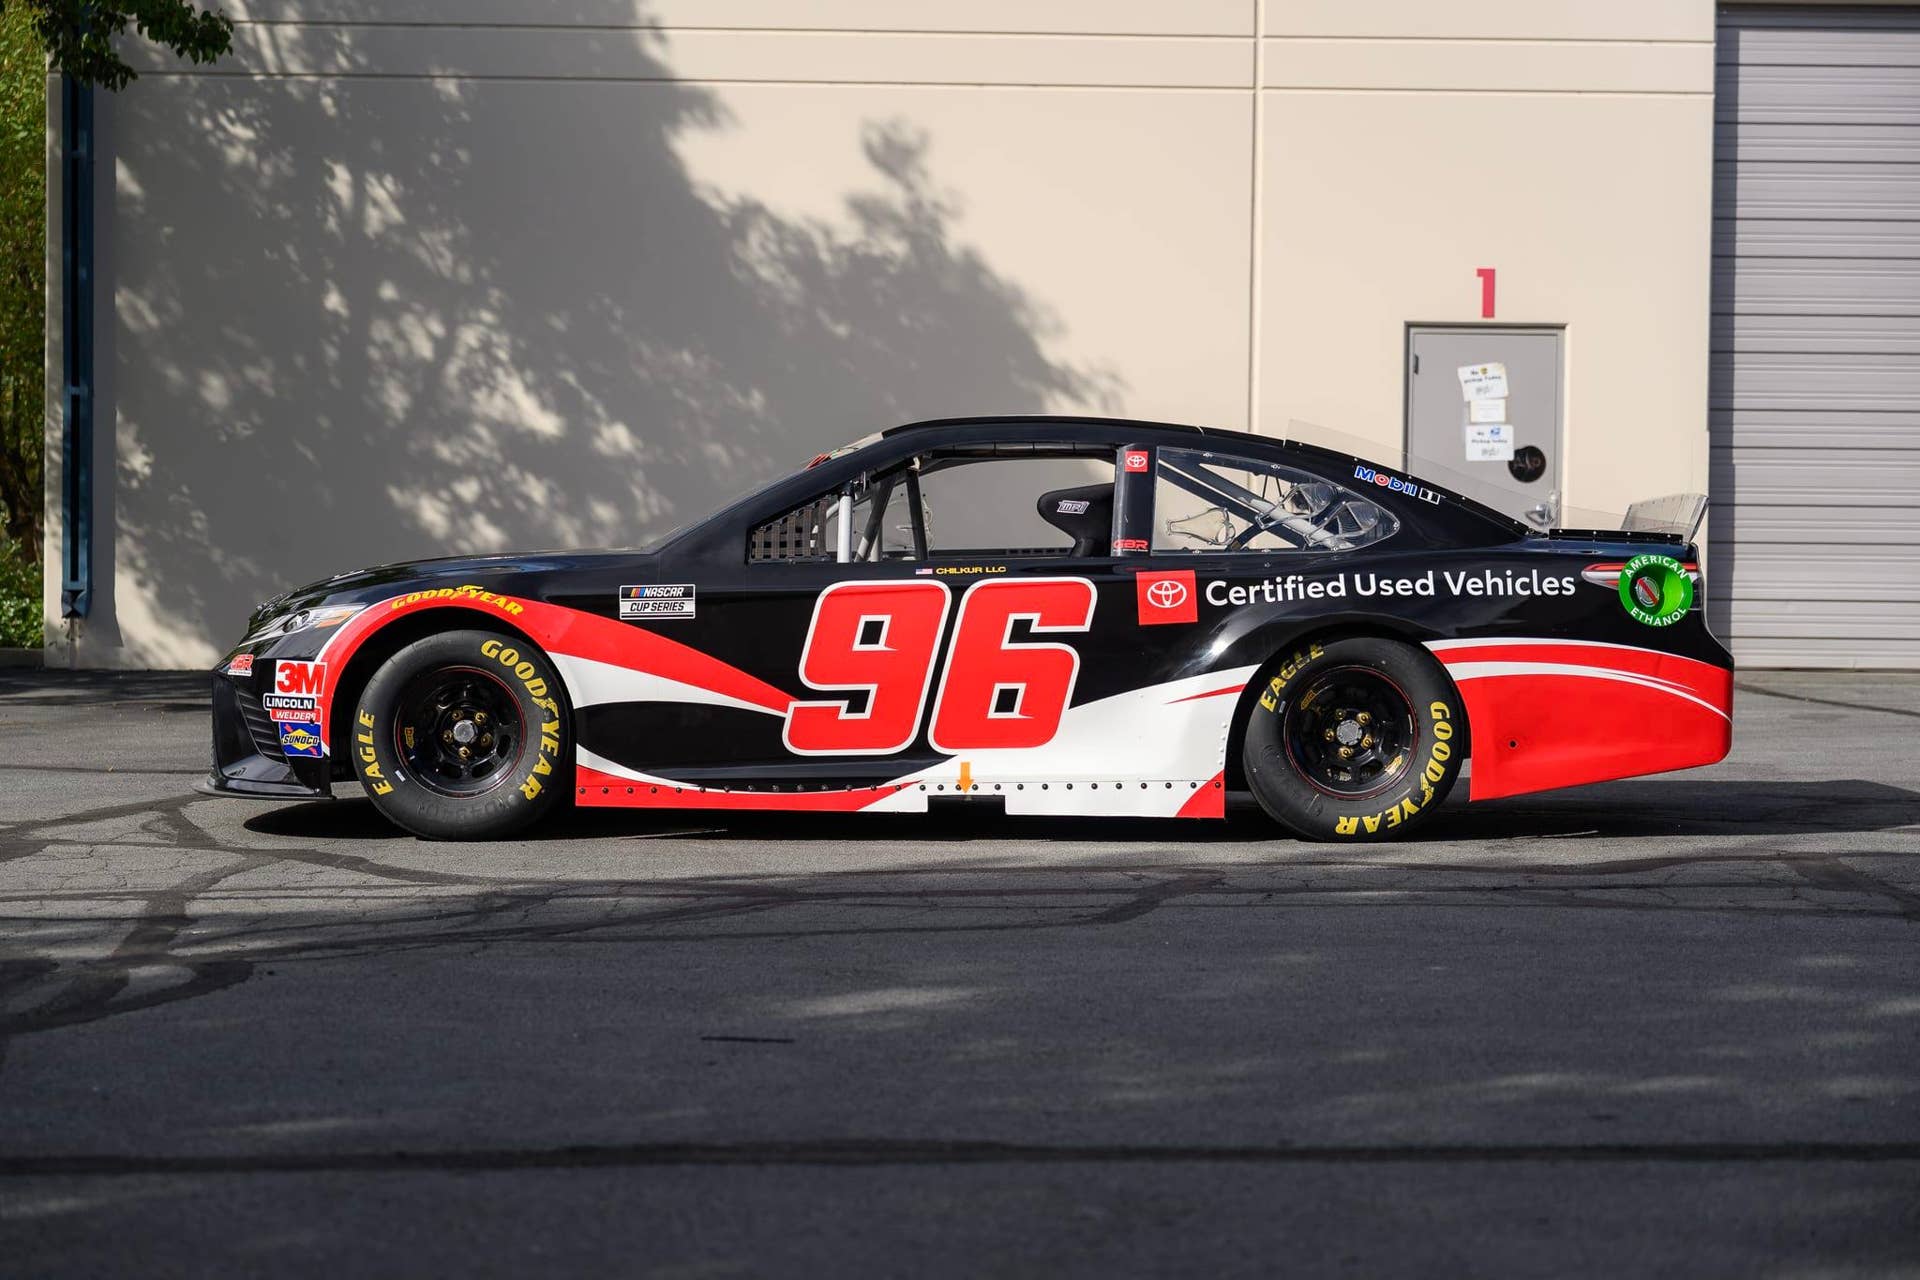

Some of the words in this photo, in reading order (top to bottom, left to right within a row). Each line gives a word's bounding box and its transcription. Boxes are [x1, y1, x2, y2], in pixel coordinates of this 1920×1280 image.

[1476, 268, 1496, 319] 1
[1354, 465, 1418, 497] Mobil
[1113, 538, 1149, 549] GBR
[935, 566, 983, 575] CHILKUR
[1625, 555, 1688, 580] AMERICAN
[391, 584, 524, 616] GOODYEAR
[643, 586, 685, 598] NASCAR
[1205, 573, 1346, 606] Certified
[1353, 570, 1435, 597] Used
[1443, 569, 1576, 597] Vehicles
[629, 602, 650, 612] CUP
[650, 601, 686, 612] SERIES
[1630, 607, 1687, 627] ETHANOL
[276, 662, 327, 695] 3M
[781, 577, 1099, 757] 96
[266, 697, 313, 710] LINCOLN
[276, 710, 316, 721] WELDERS
[480, 638, 560, 801] GOODYEAR
[282, 734, 319, 746] SUNOCO
[359, 708, 395, 797] EAGLE
[1334, 701, 1453, 835] GOODYEAR
